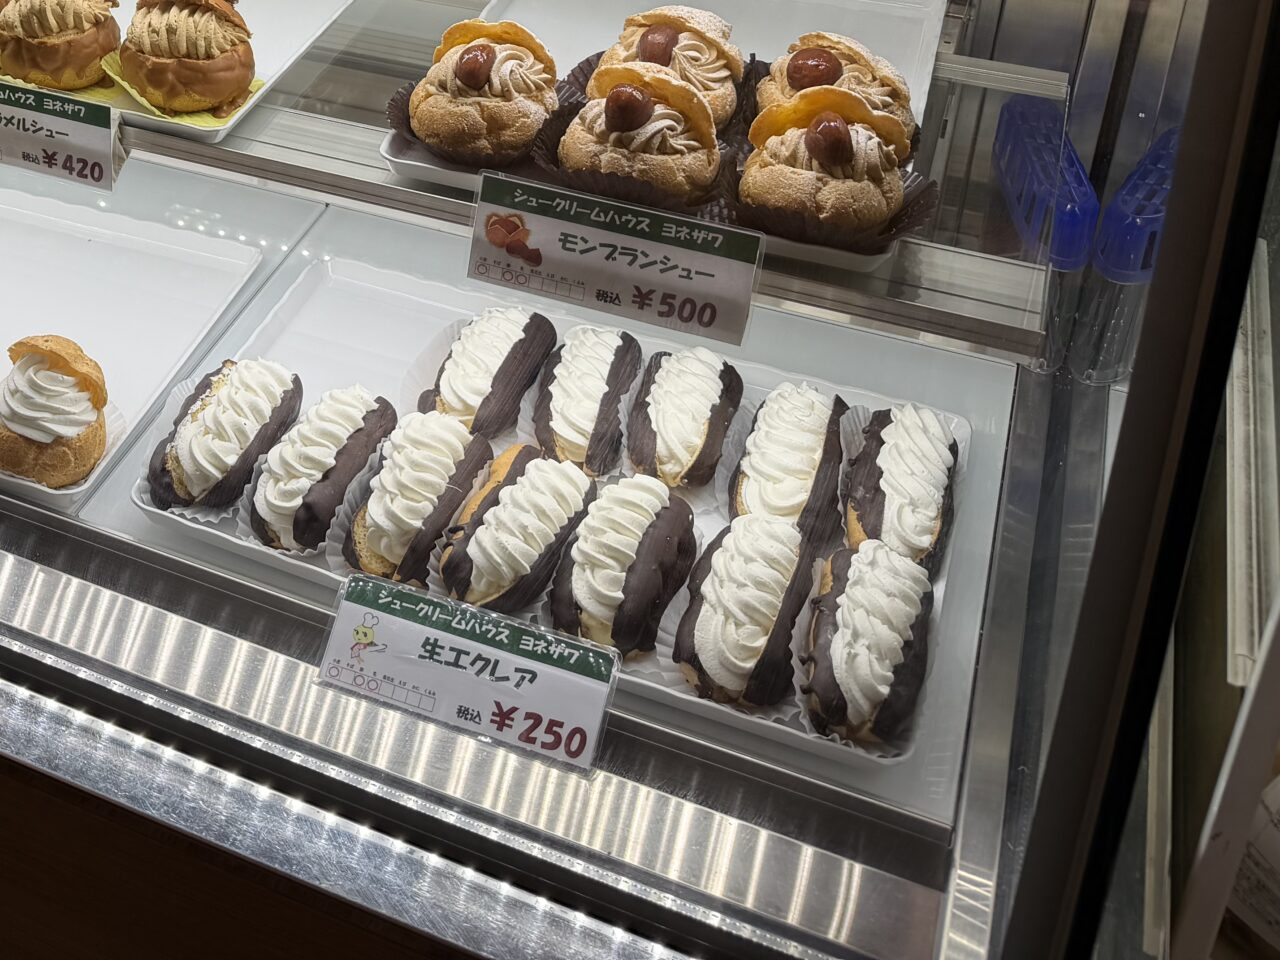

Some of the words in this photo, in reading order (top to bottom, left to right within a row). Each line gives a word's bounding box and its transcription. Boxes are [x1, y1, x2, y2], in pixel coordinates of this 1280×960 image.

[43, 98, 86, 118] ヨネザワ
[21, 150, 41, 166] 税込
[41, 148, 104, 183] ¥420
[512, 188, 652, 233] シュークリームハウス
[661, 222, 724, 248] ヨネザワ
[558, 231, 716, 281] モンブランシュー
[595, 288, 622, 308] 税込
[631, 284, 718, 329] ¥500
[377, 590, 511, 644] シュークリームハウス
[519, 635, 581, 664] ヨネザワ
[418, 636, 539, 690] 生エクレア
[456, 704, 484, 726] 税込
[489, 700, 588, 760] ¥250
